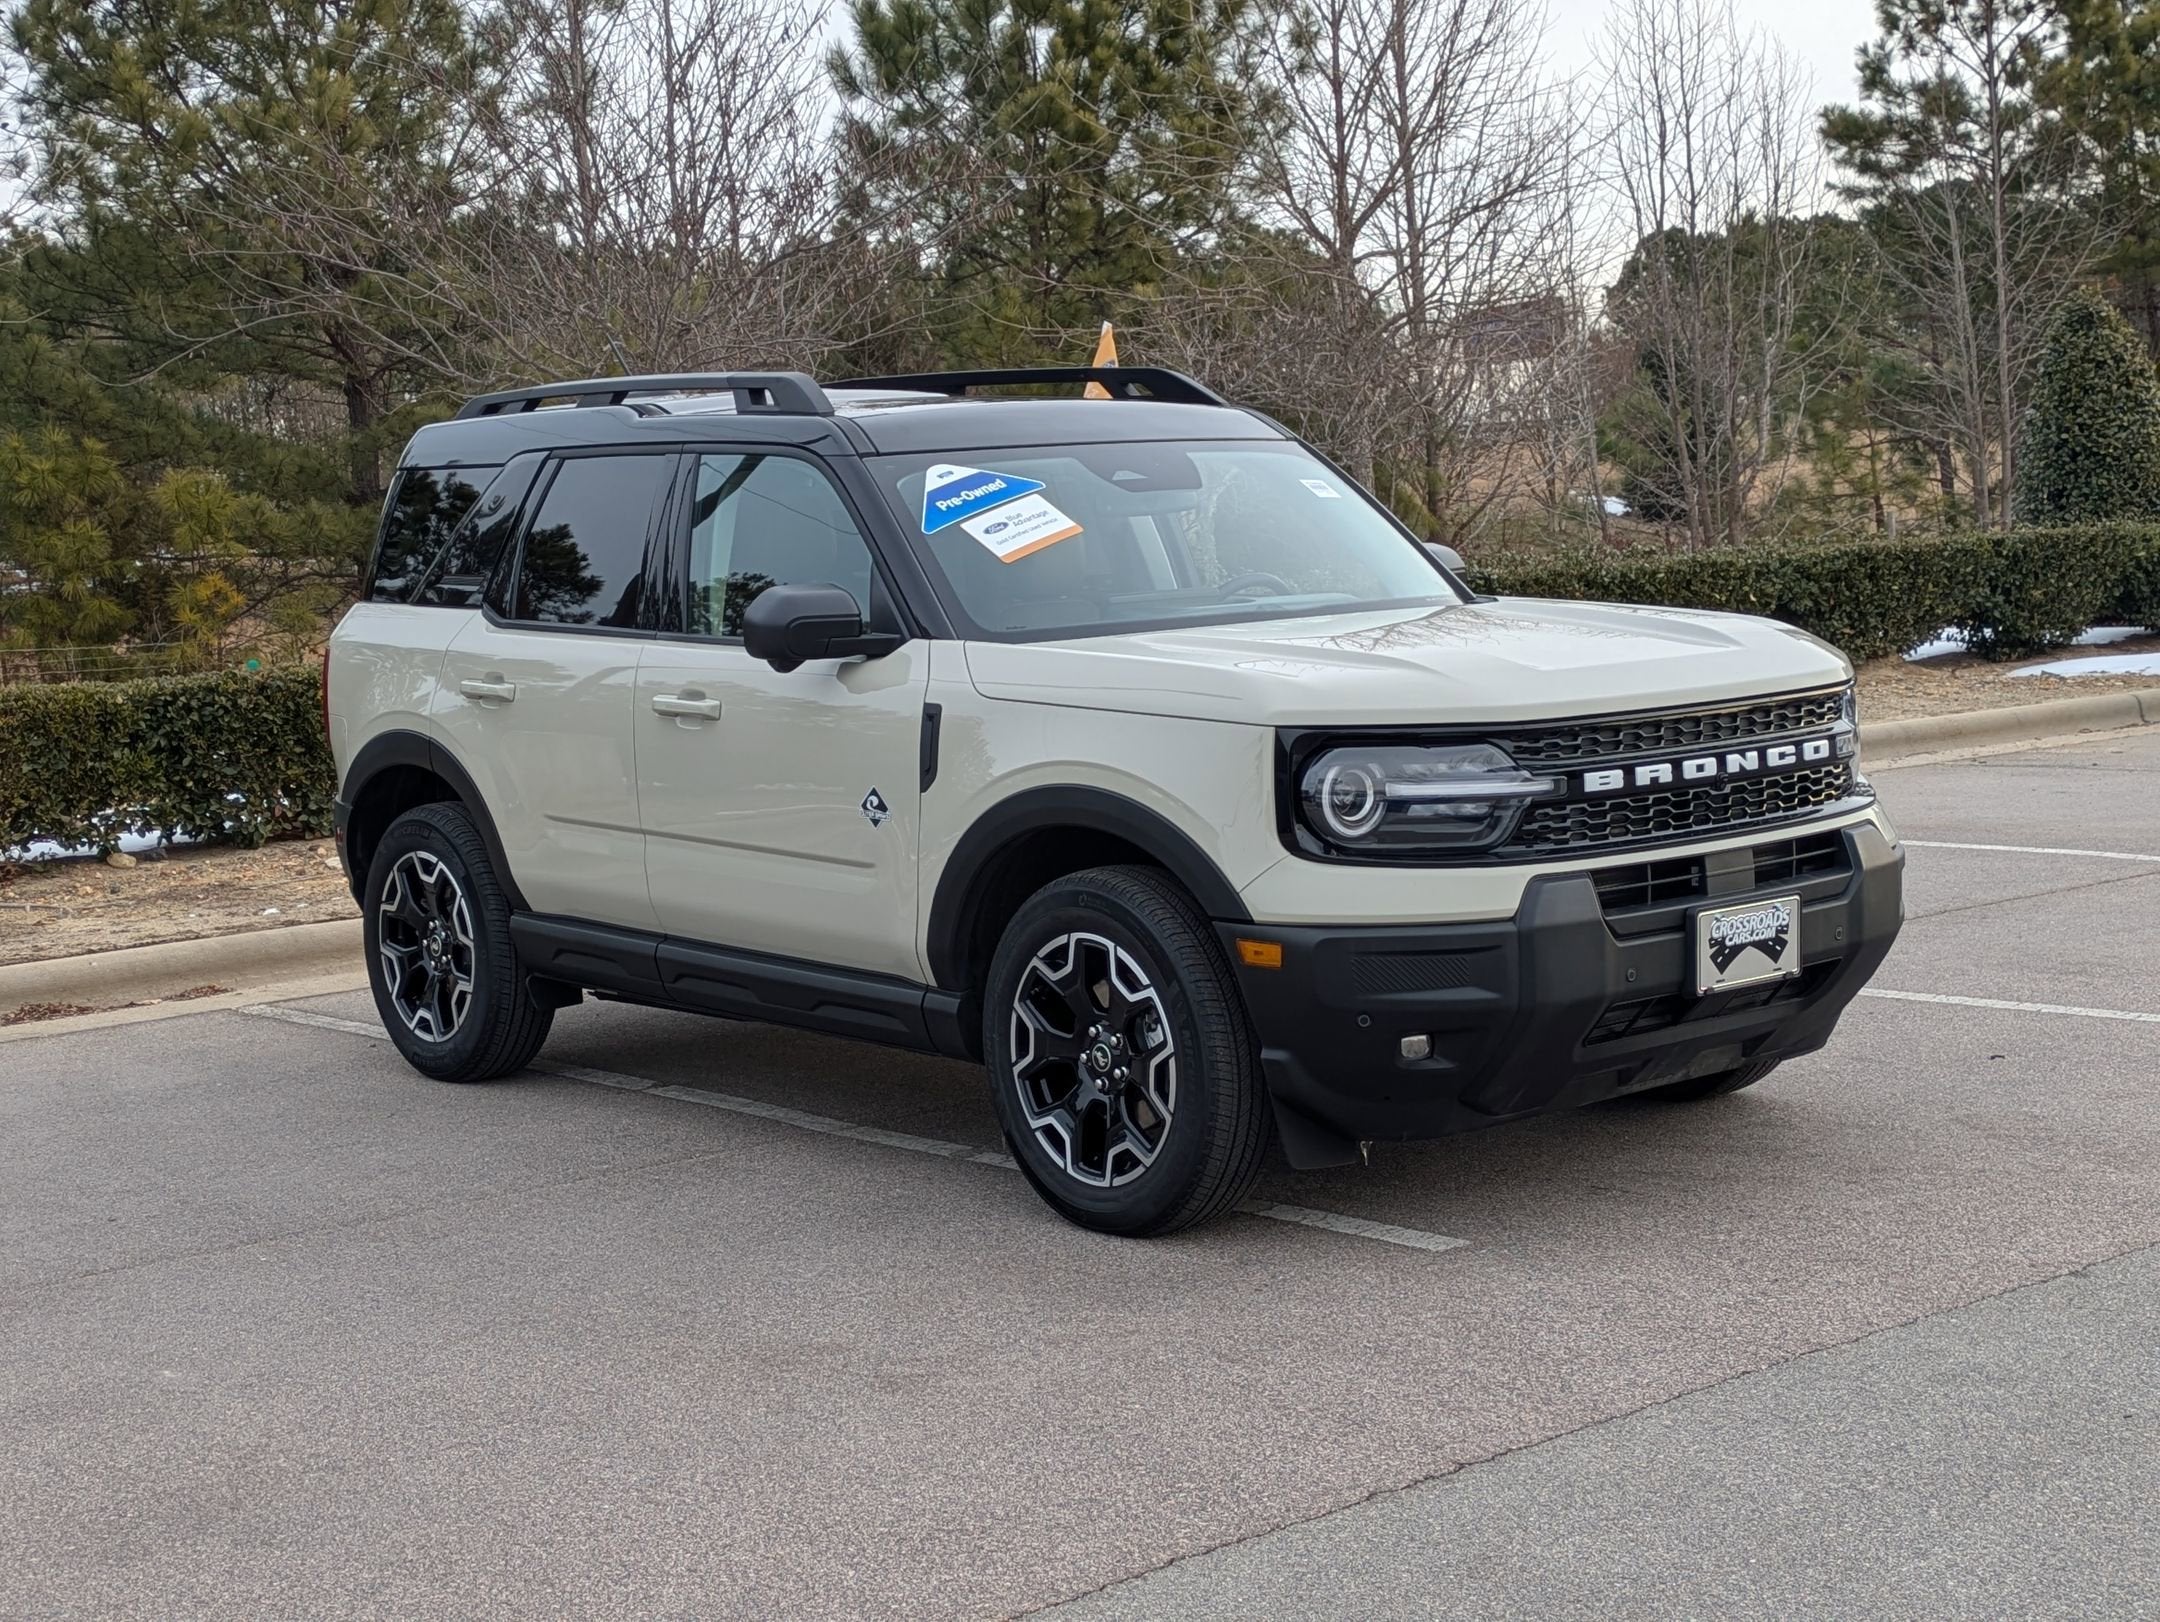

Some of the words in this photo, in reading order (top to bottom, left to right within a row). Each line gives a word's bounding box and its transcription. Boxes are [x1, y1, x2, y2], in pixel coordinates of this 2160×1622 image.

[935, 479, 1007, 511] Pre-Owned
[986, 522, 1007, 534] Ford
[1583, 740, 1829, 792] BRONCO
[1711, 908, 1791, 938] CROSSROADS
[1725, 927, 1777, 946] CARS.COM
